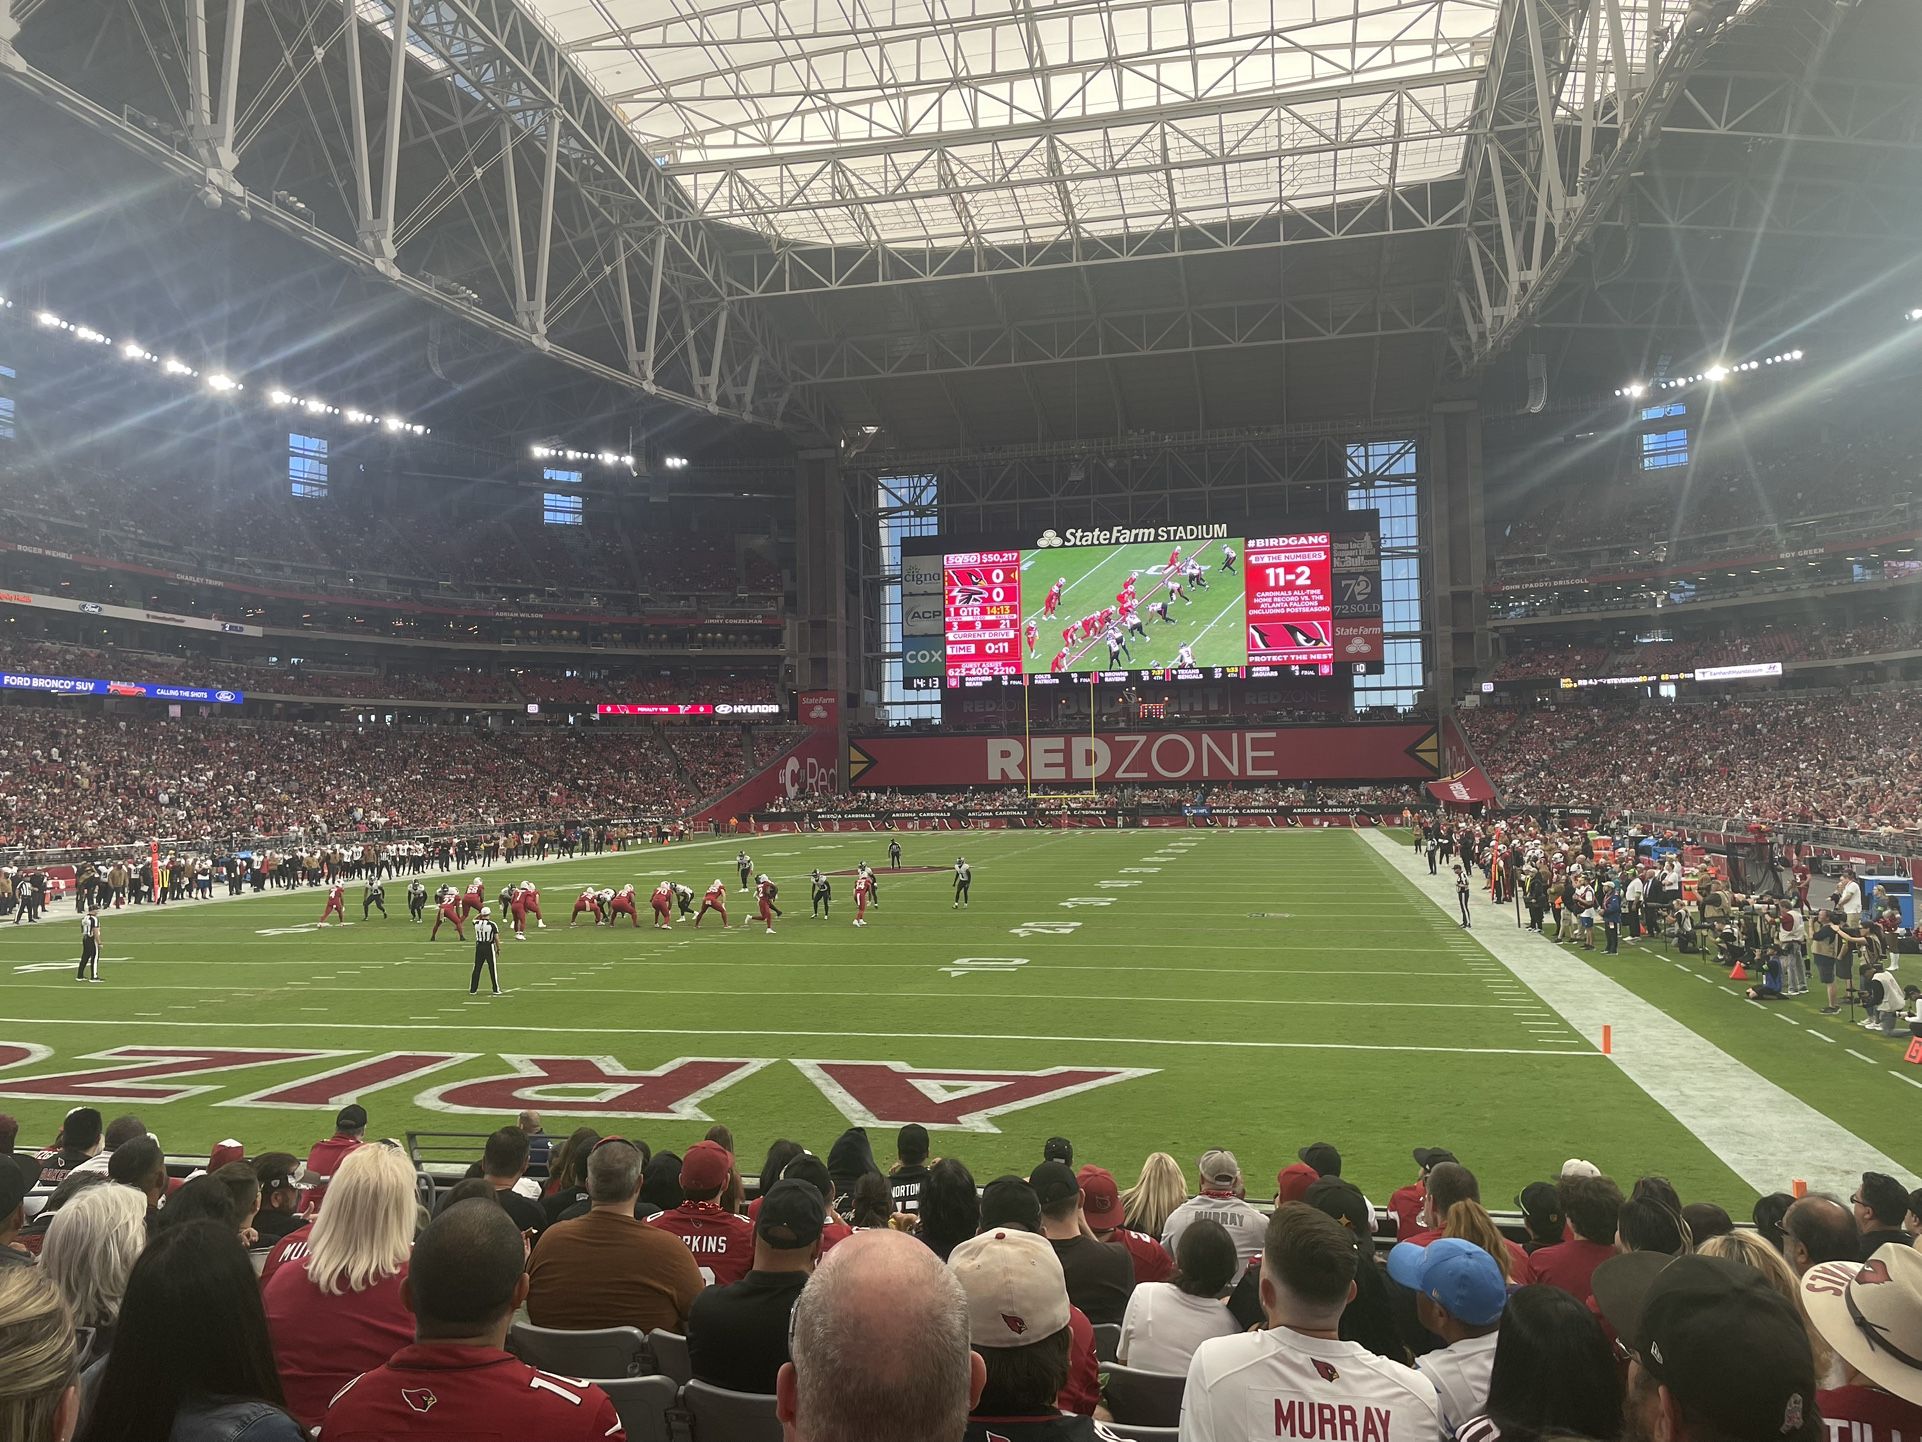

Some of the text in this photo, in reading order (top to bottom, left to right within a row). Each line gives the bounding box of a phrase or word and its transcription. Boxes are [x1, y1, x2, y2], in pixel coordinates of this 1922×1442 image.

[1157, 524, 1226, 540] STADIUM
[1247, 535, 1328, 548] #BIRDGANG
[981, 553, 1018, 563] $50,217
[1285, 552, 1322, 560] NUMBERS
[904, 571, 941, 585] cigna
[992, 569, 1004, 583] 0
[1265, 565, 1311, 587] 11-2
[1554, 578, 1589, 586] DRISCOLL
[1341, 575, 1371, 601] 72
[992, 588, 1004, 602] 0
[1253, 596, 1273, 604] HOME
[911, 610, 942, 619] ACP
[949, 605, 1011, 617] 1 QTR 14:13
[1286, 605, 1330, 613] POSTSEASON)
[952, 619, 1010, 630] 3 9 21
[950, 642, 1009, 653] TIME 0:11
[905, 650, 942, 663] COX
[948, 667, 1017, 677] 623-400-2210
[1356, 663, 1365, 673] 10
[4, 676, 30, 686] FORD
[75, 681, 95, 690] SUV
[913, 677, 940, 689] 14:13
[157, 688, 178, 697] CALLING
[191, 691, 207, 699] SHOTS
[734, 704, 779, 713] HYUNDAI
[1273, 1398, 1392, 1442] MURRAY
